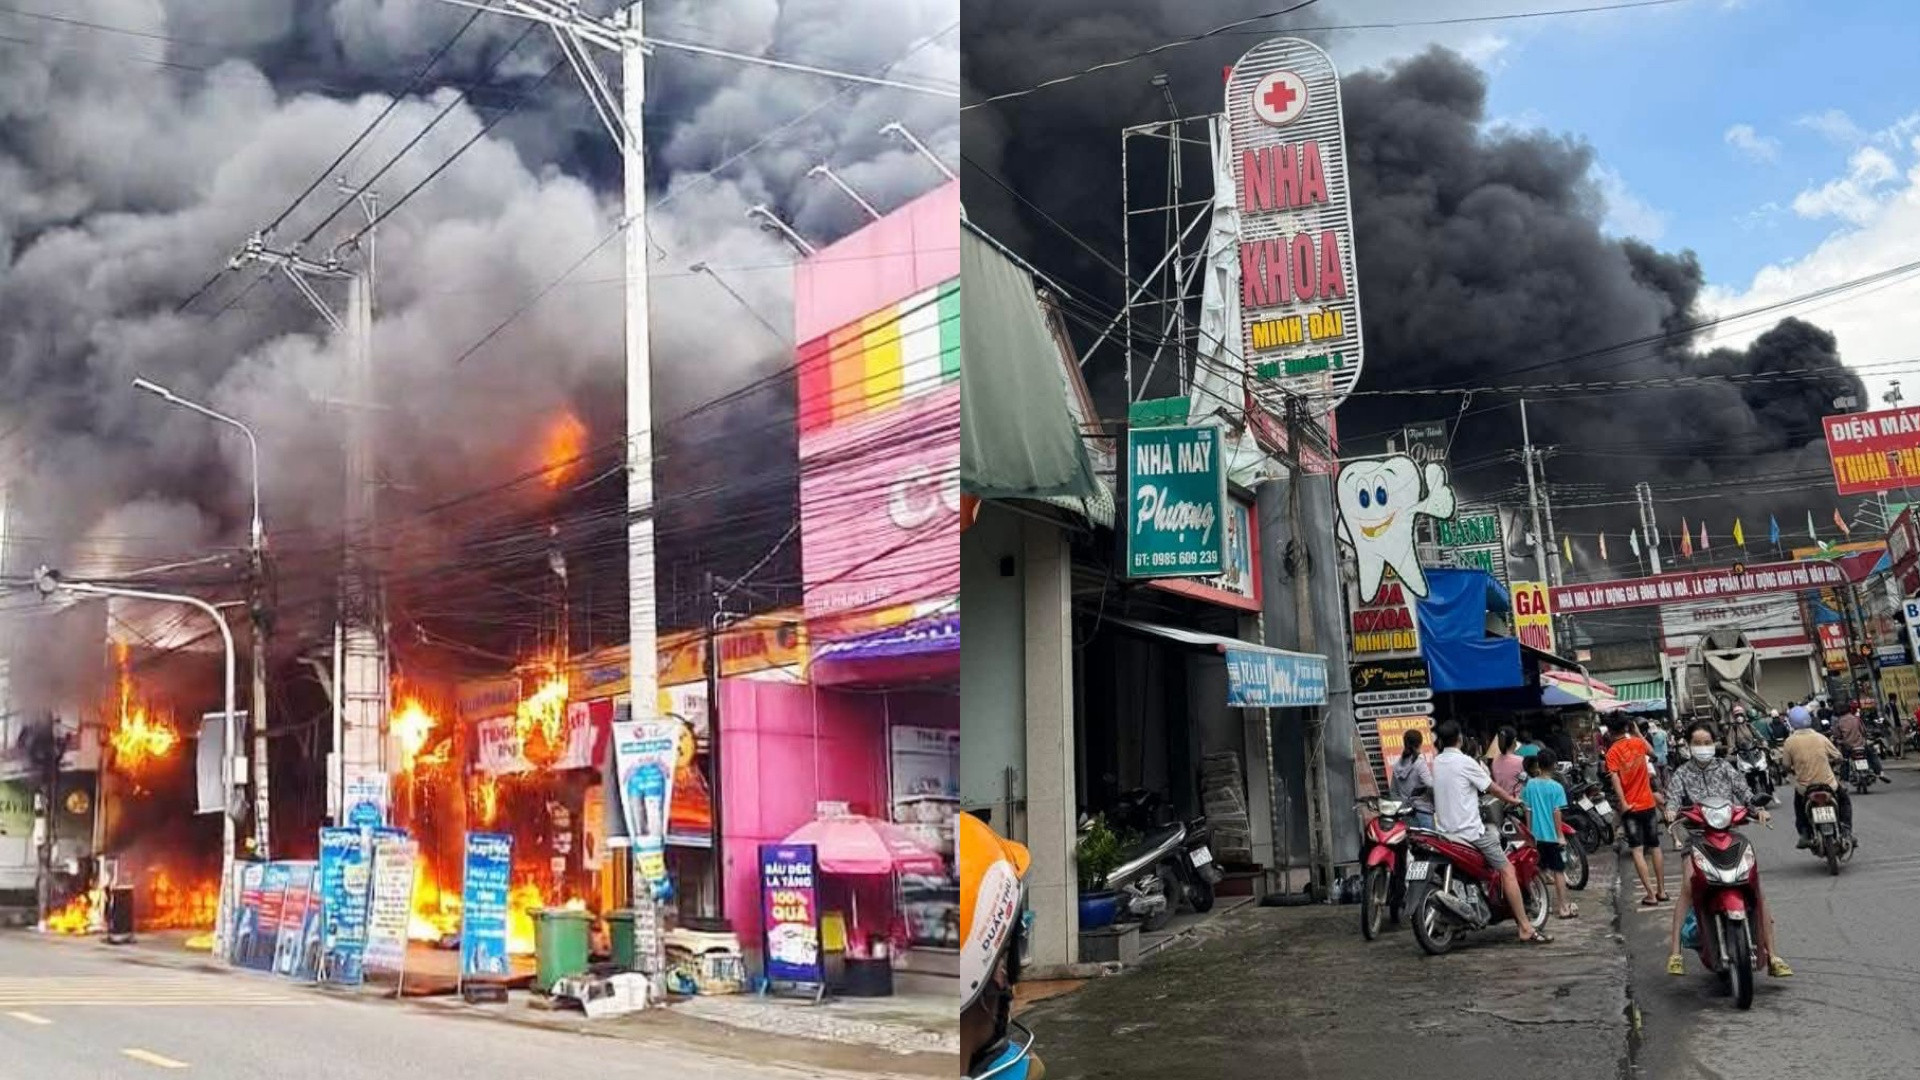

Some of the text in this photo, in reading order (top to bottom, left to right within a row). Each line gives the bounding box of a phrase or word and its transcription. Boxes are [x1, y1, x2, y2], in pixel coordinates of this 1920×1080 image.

[1242, 139, 1330, 214] NHA
[1240, 229, 1346, 308] KHOA
[1252, 315, 1303, 350] MINH
[1831, 416, 1878, 443] ĐIỆN
[1136, 436, 1211, 475] NHÀ MAY
[1136, 484, 1215, 545] Phượng
[1152, 552, 1177, 566] 0985
[1178, 551, 1197, 565] 609
[1199, 550, 1218, 564] 239
[1516, 585, 1547, 615] GÀ
[1355, 632, 1391, 653] MINH
